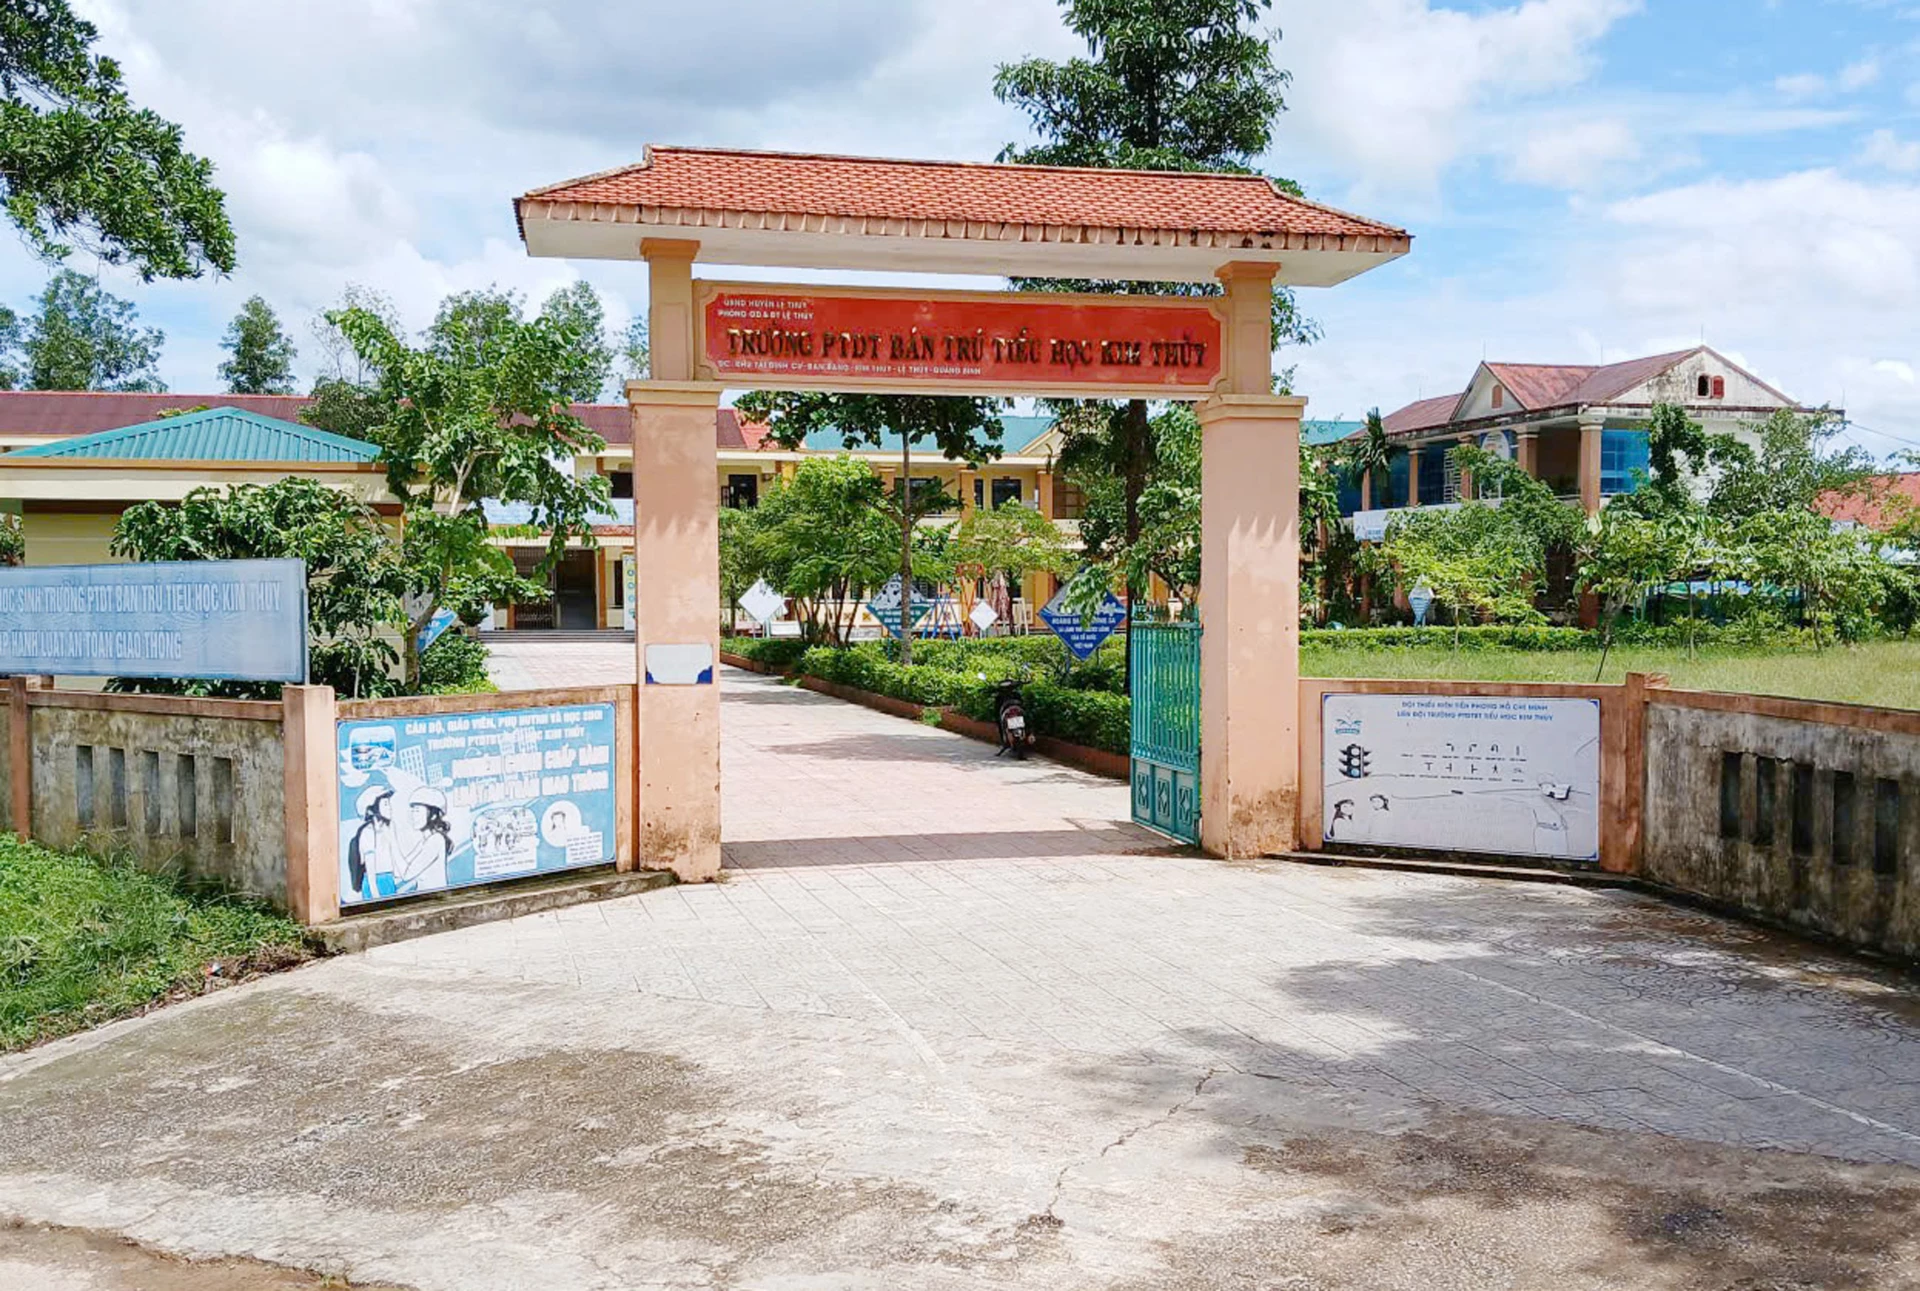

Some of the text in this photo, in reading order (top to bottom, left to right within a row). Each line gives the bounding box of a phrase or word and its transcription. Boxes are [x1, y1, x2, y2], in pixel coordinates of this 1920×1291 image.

[727, 320, 1207, 371] TRƯỜNG PTDT BÁN TRÚ TIỂU HỌC KIM THỦY
[87, 585, 113, 612] PTDT
[194, 582, 219, 618] HỌC
[222, 583, 246, 611] KIM
[115, 630, 141, 658] GIAO
